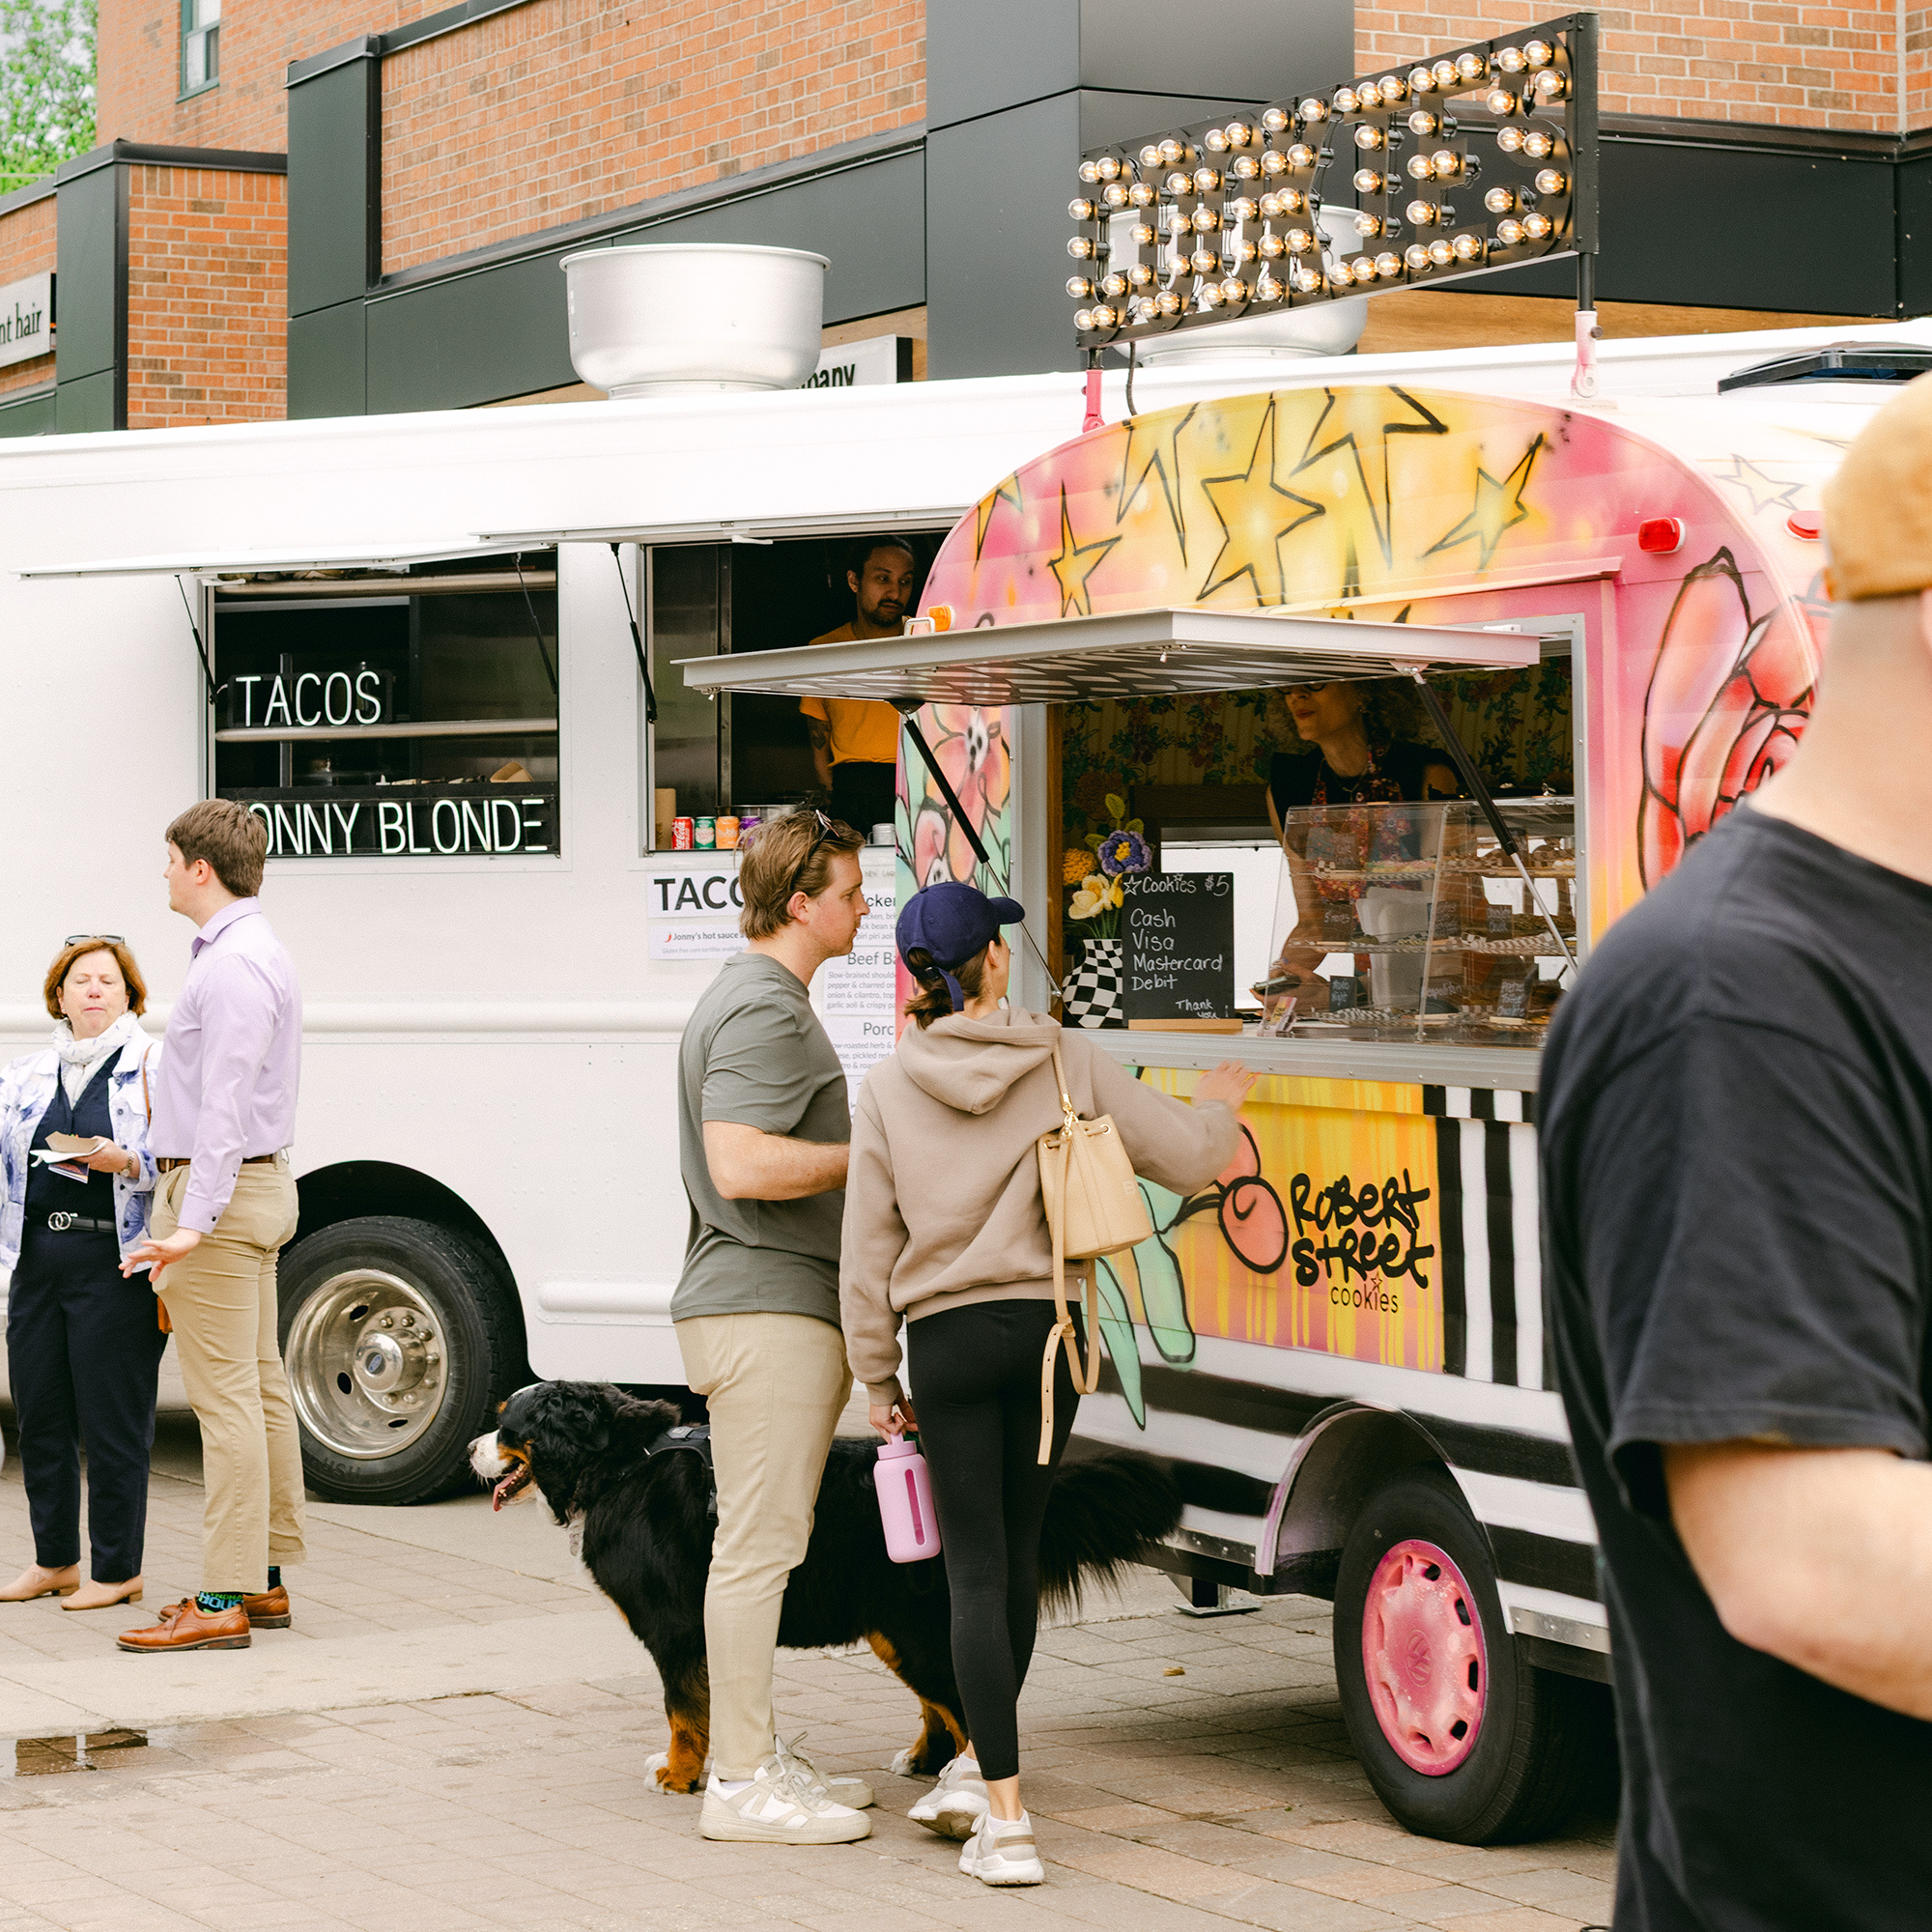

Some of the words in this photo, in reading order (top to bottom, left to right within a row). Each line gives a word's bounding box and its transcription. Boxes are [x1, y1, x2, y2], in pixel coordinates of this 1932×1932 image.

[1066, 35, 1571, 337] COOKIES
[15, 302, 42, 339] hair
[236, 670, 382, 727] TACOS
[379, 799, 548, 855] BLONDE
[1142, 874, 1197, 894] Cookies
[1205, 874, 1230, 896] $5
[1130, 908, 1176, 927] Cash
[673, 932, 701, 942] Jonny's
[702, 931, 717, 940] hot
[1132, 928, 1175, 952] Visa
[847, 952, 879, 965] Beef
[1133, 952, 1223, 973] Mastercard
[1131, 974, 1179, 991] Debit
[1175, 998, 1214, 1011] Thank
[1330, 1275, 1399, 1313] cookies
